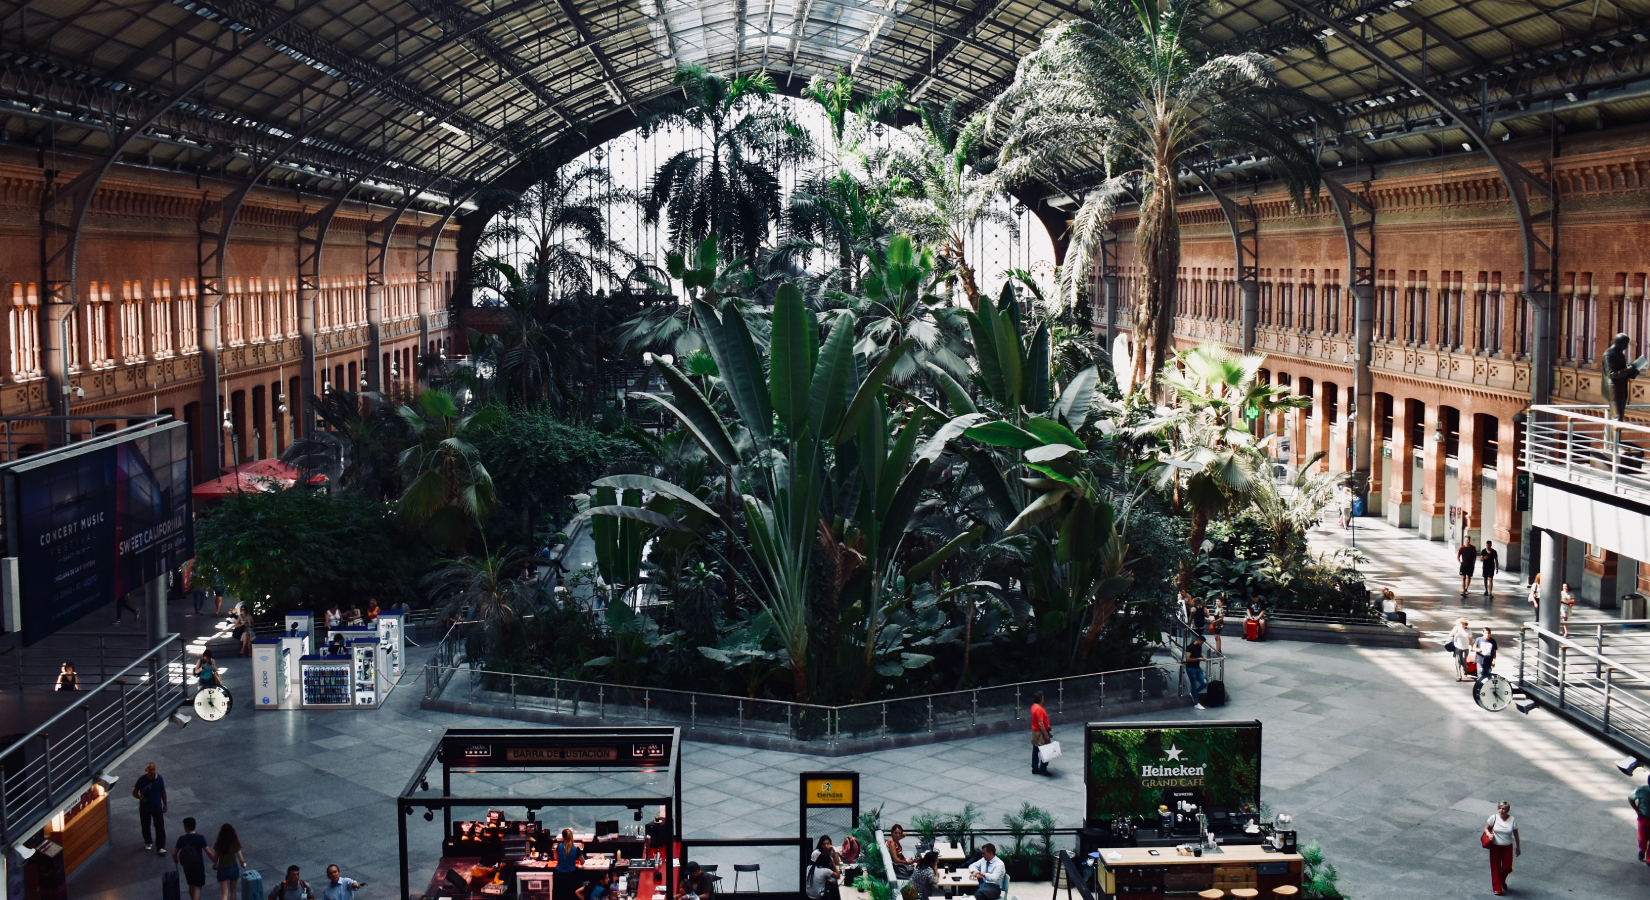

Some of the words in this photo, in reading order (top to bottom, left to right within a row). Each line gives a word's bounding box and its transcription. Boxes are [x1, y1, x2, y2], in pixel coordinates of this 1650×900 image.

[40, 522, 77, 546] CONCERT
[81, 511, 105, 530] MUSIC
[50, 533, 97, 556] FESTIVAL
[119, 532, 143, 556] SWEET
[513, 750, 544, 758] BARRA
[546, 748, 610, 758] DEUSTACIÓN
[1142, 765, 1204, 776] Heineken
[1142, 779, 1177, 788] GRAND
[1180, 776, 1204, 787] CAFÉ
